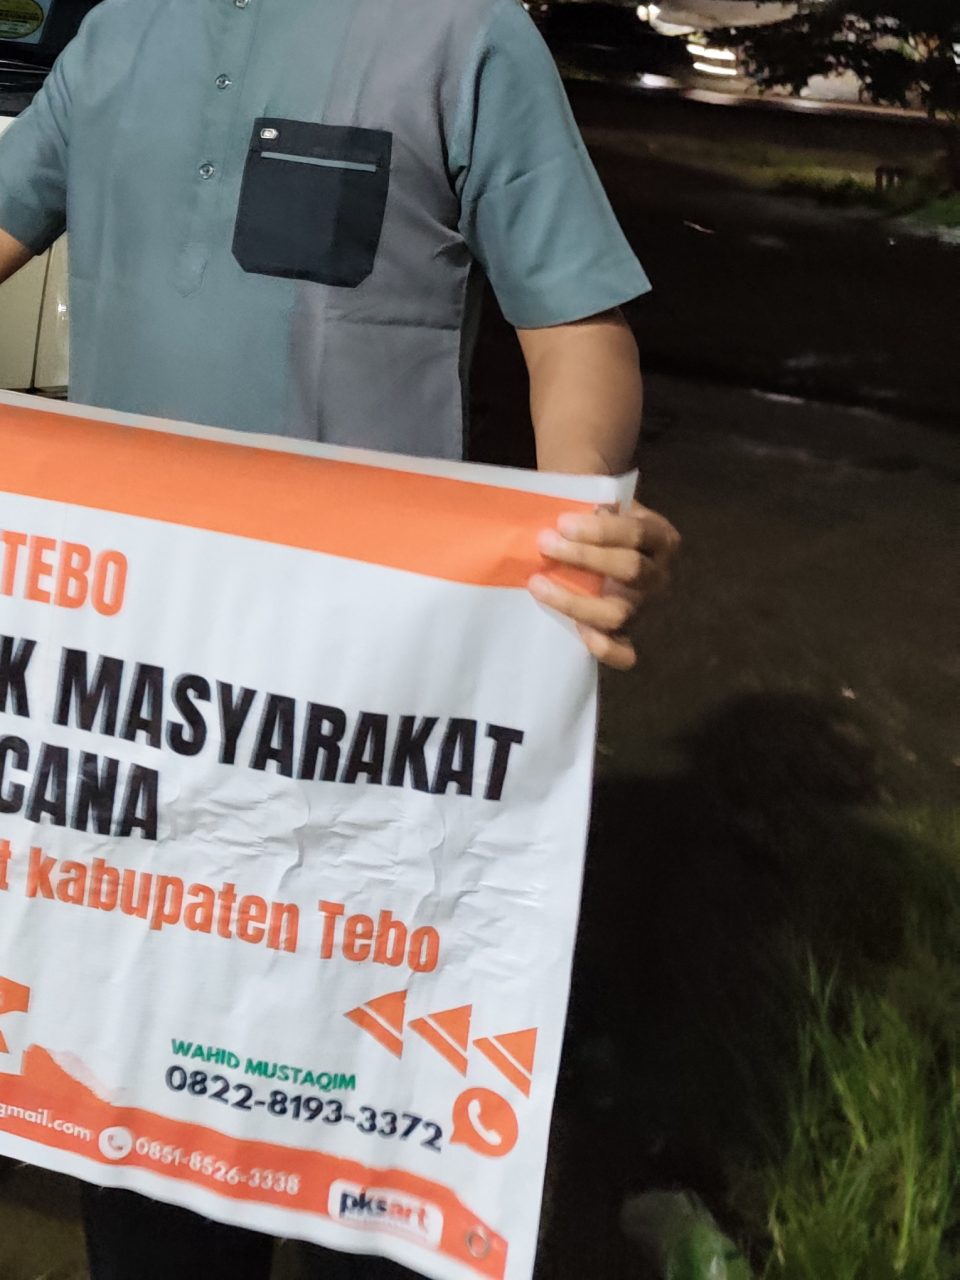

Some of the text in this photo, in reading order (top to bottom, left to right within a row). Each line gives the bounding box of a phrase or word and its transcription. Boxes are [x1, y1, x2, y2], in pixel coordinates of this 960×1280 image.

[52, 646, 525, 802] MASYARAKAT
[25, 846, 300, 953] kabupaten
[318, 899, 441, 973] Tebo
[165, 1064, 443, 1153] 0822-8193-3372
[171, 1038, 356, 1091] WAHID MUSTAQIM
